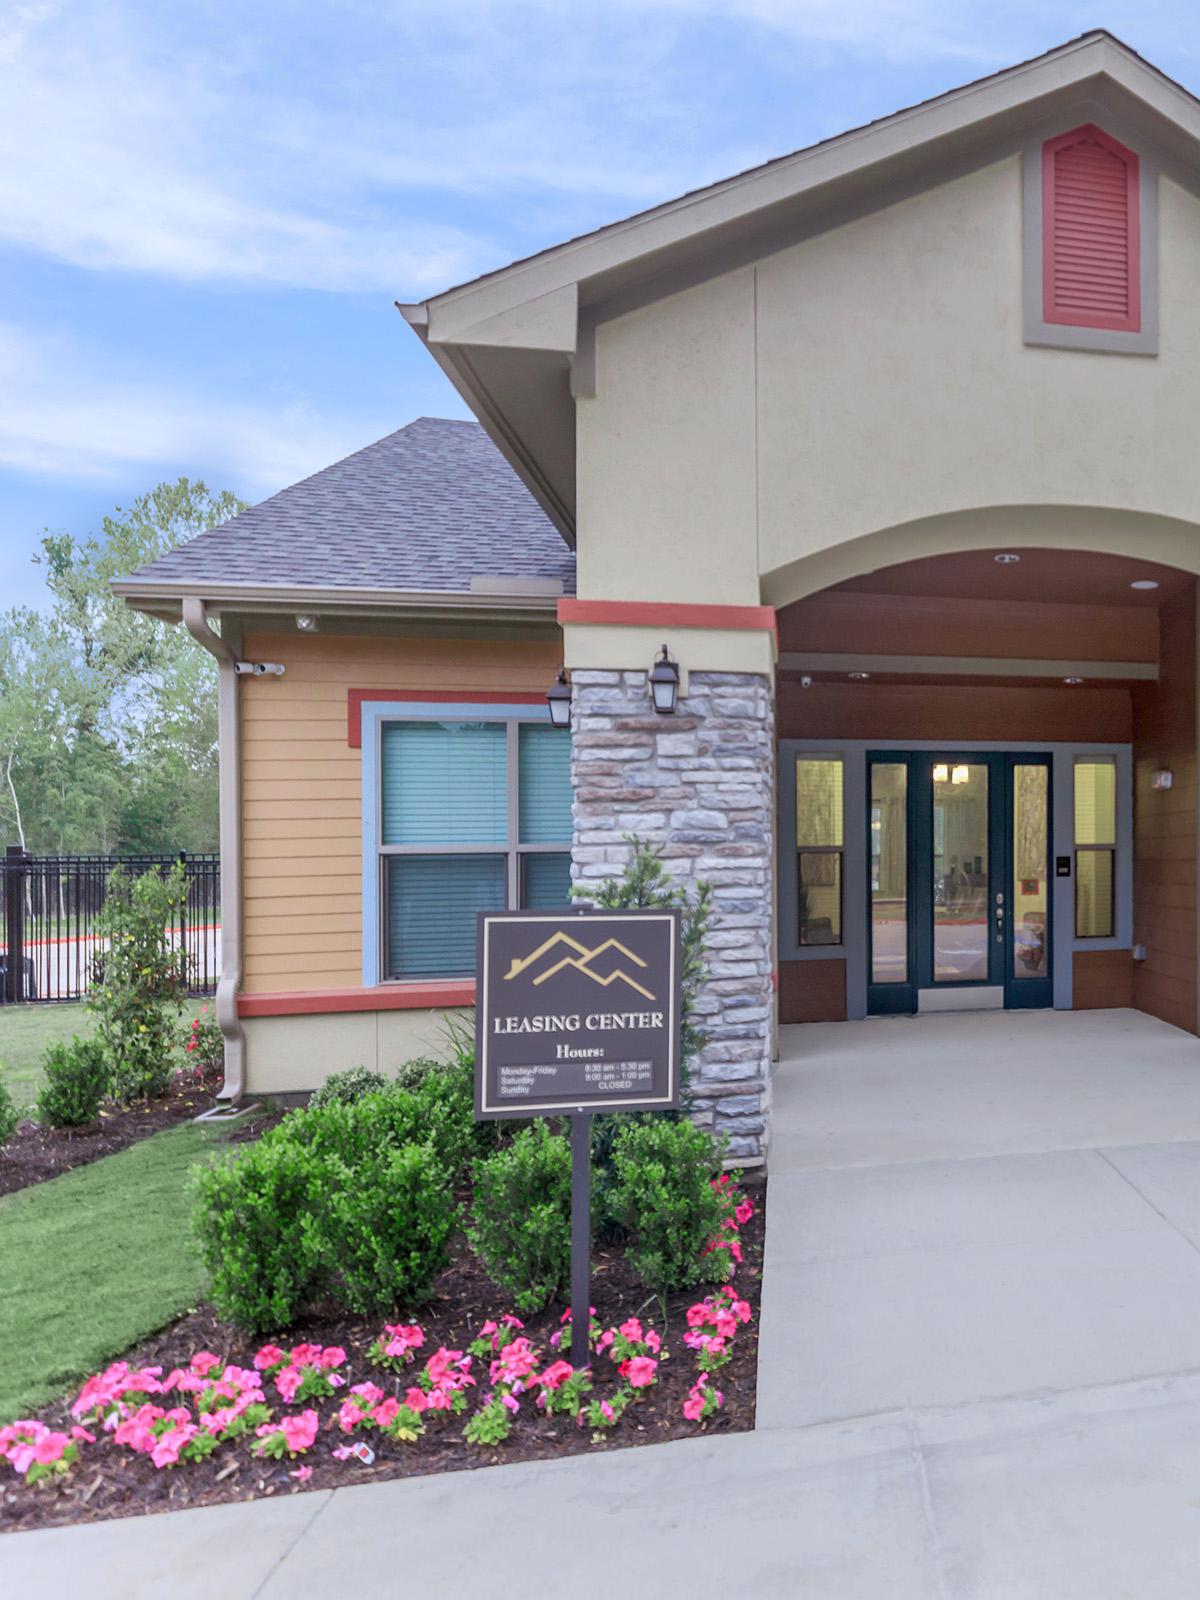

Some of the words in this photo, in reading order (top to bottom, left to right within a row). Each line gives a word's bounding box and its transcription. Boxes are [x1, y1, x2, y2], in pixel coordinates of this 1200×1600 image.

[493, 1015, 580, 1034] LEASING
[585, 1012, 663, 1030] CENTER
[556, 1044, 604, 1059] Hours:
[501, 1076, 534, 1086] Saturday
[501, 1086, 529, 1095] Sunday
[598, 1080, 632, 1089] CLOSED
